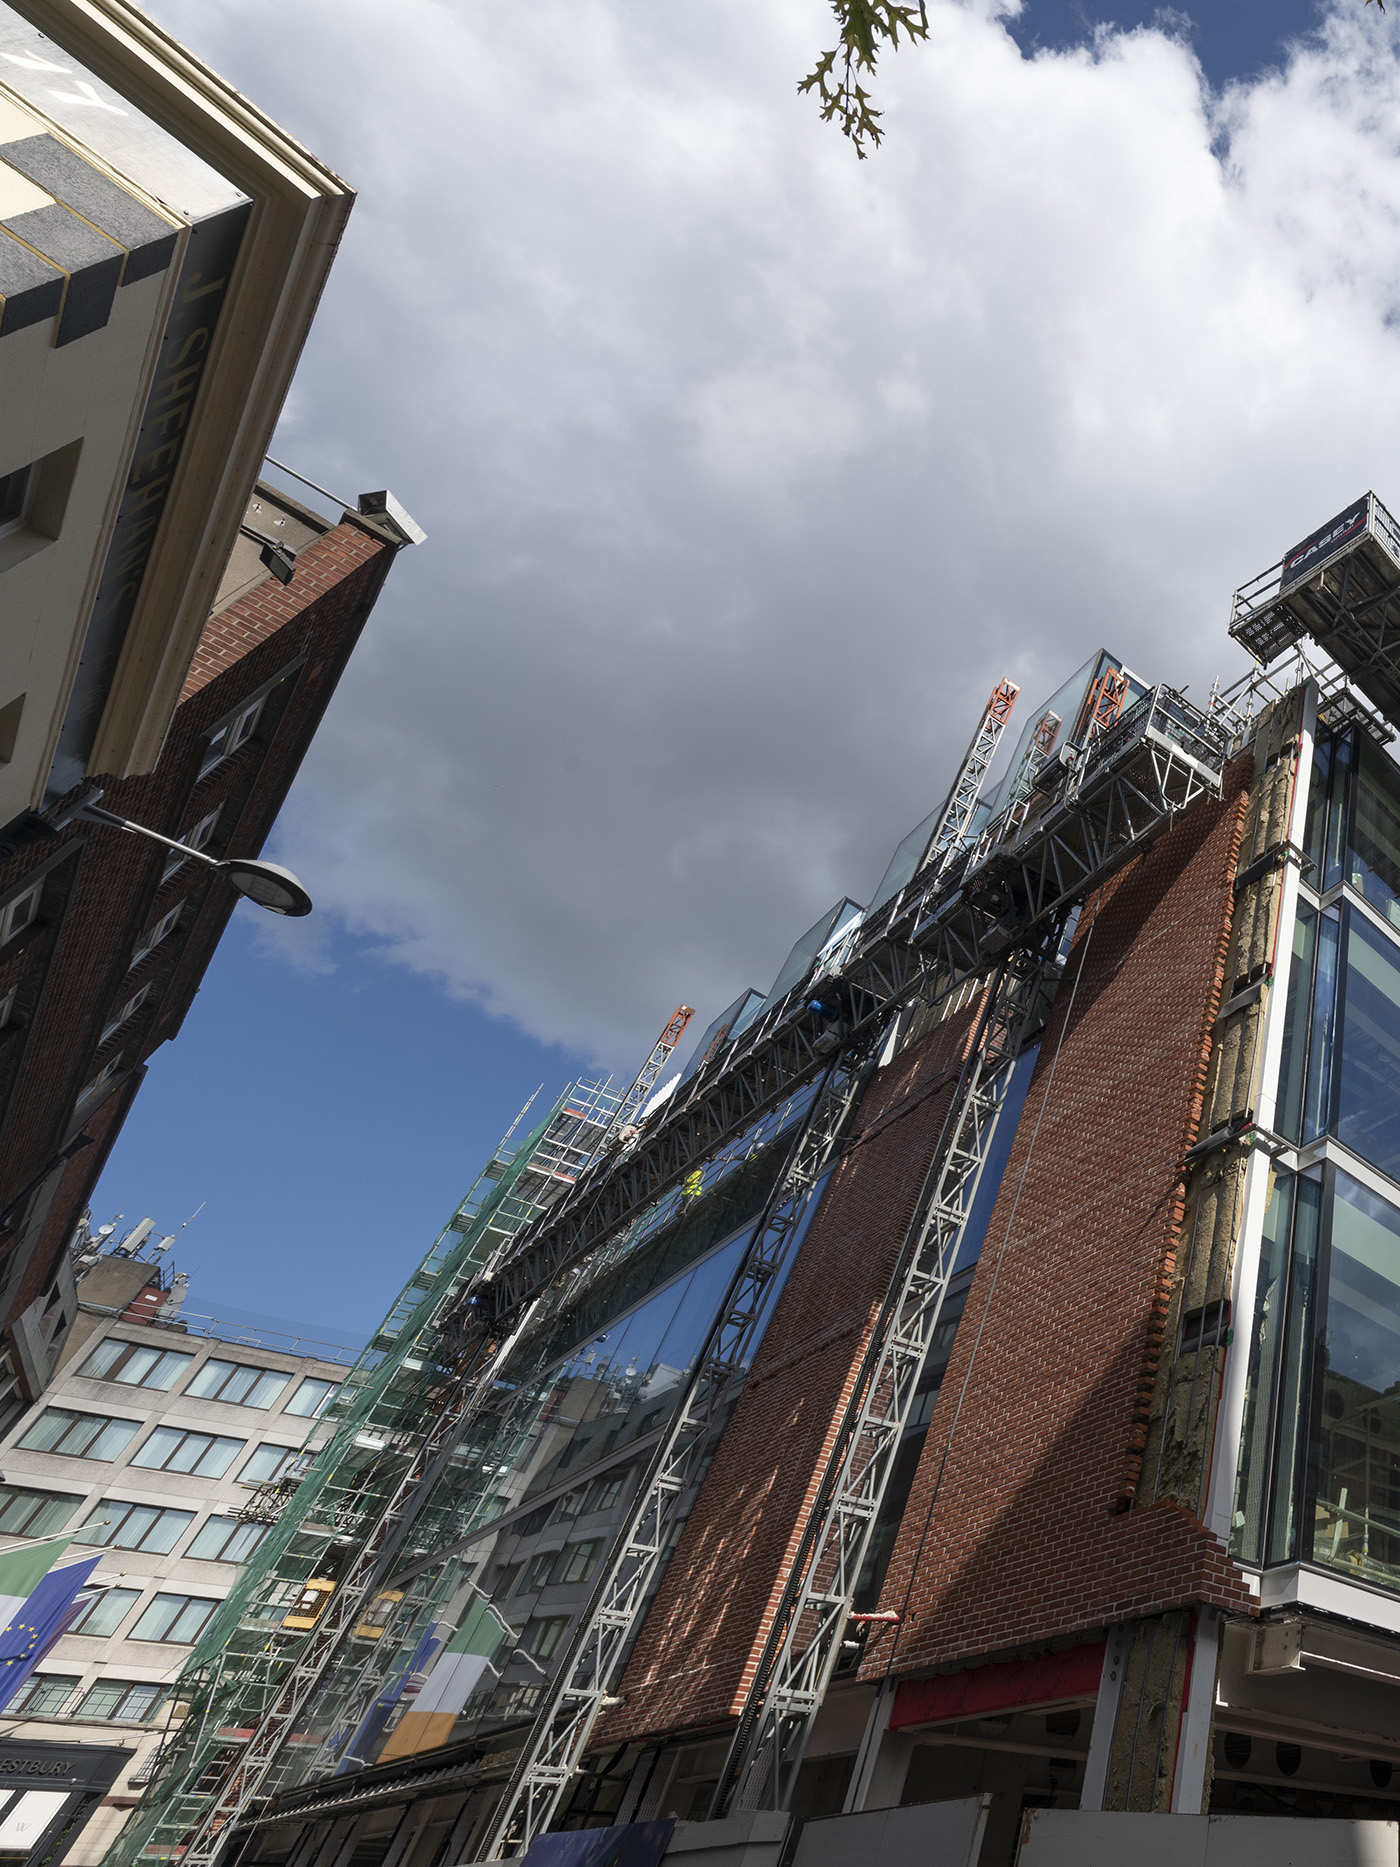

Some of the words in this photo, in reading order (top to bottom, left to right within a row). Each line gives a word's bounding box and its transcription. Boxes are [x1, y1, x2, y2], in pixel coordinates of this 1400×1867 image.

[97, 327, 209, 622] SHEEHAN'S
[1290, 511, 1360, 568] CASEY
[0, 1758, 75, 1776] ESTBURY
